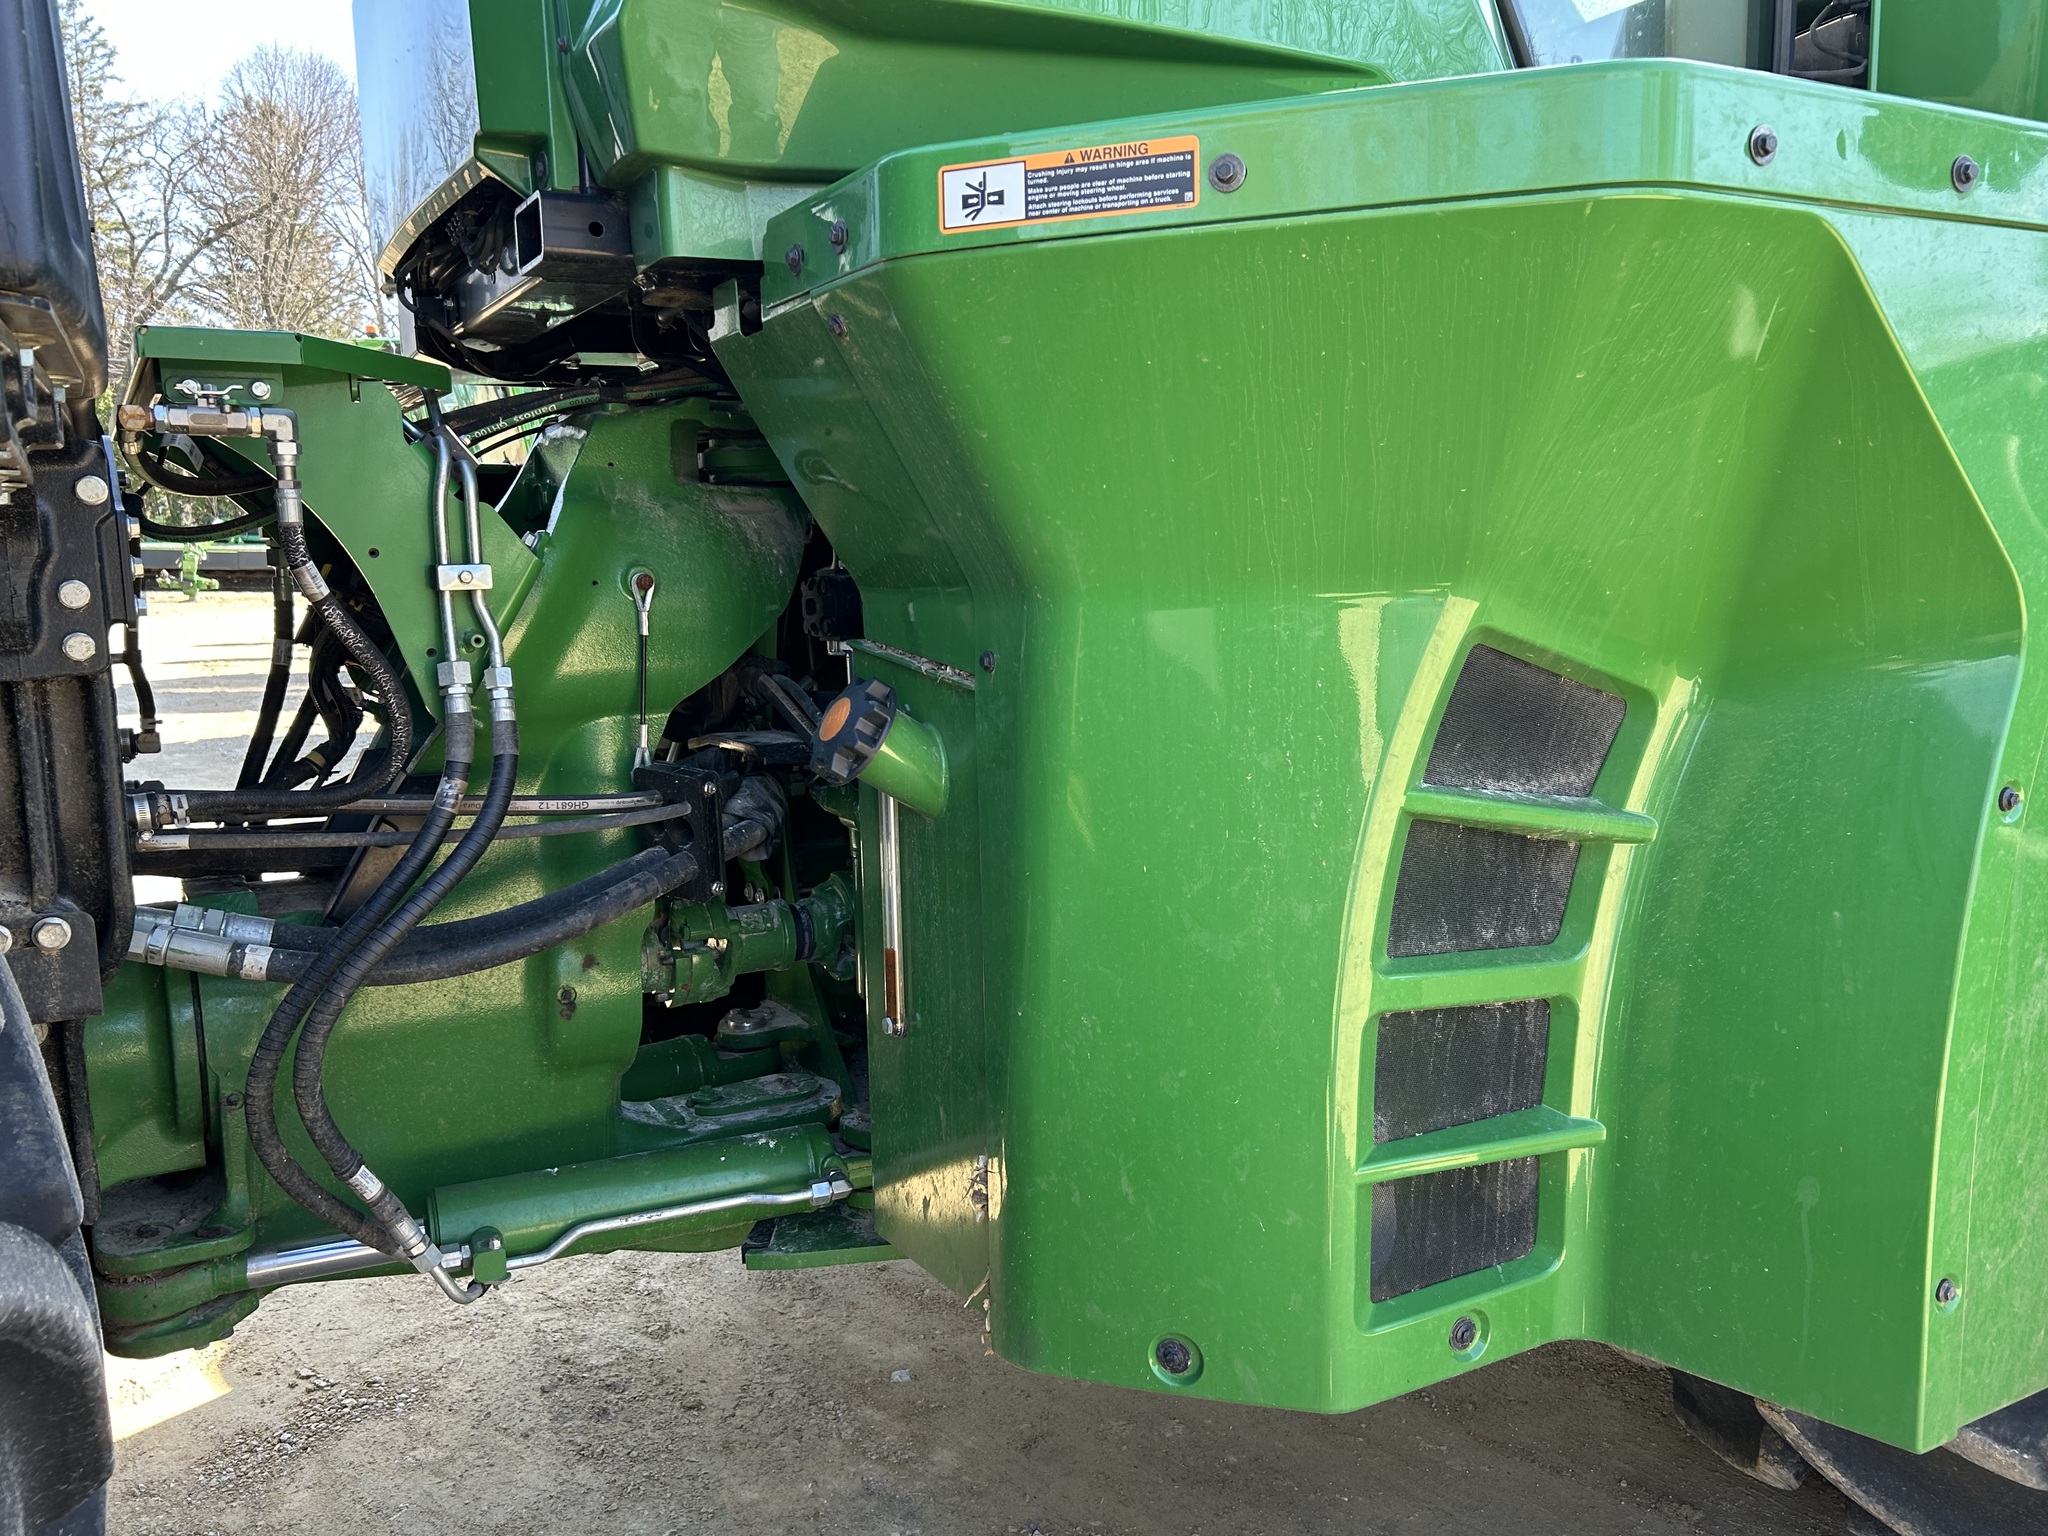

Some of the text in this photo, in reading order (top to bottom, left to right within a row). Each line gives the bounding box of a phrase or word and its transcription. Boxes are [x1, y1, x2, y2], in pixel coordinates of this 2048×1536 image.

[1080, 142, 1148, 162] WARNING
[1028, 170, 1055, 178] Crushing
[1056, 168, 1074, 176] injury
[1157, 154, 1184, 163] machine
[1028, 177, 1049, 185] turned.
[1060, 183, 1079, 192] people
[1048, 200, 1072, 208] steering
[1073, 197, 1098, 205] lockouts
[1119, 191, 1152, 200] performing
[1102, 199, 1139, 208] transporting
[513, 404, 557, 422] Danfoss
[538, 801, 590, 810] GH681-12
